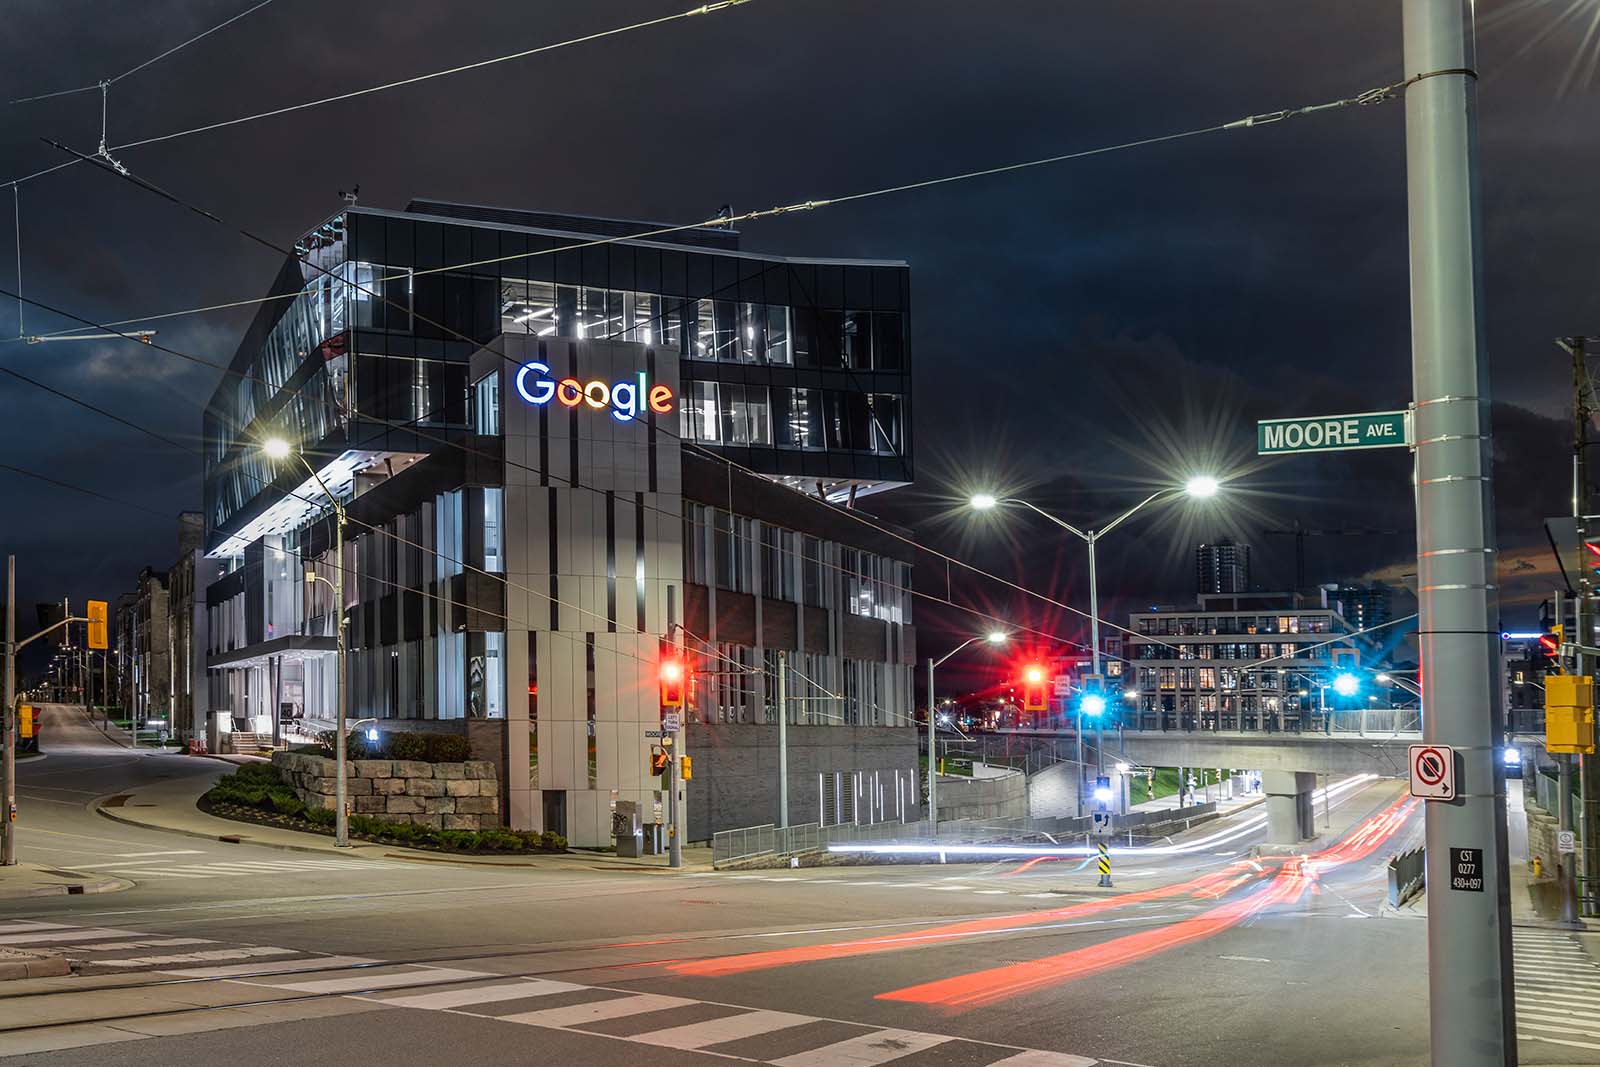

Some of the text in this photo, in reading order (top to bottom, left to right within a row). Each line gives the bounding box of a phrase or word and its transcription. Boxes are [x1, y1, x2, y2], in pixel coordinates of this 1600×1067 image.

[516, 361, 673, 422] Google
[1264, 420, 1397, 449] MOORE AVE.
[1460, 850, 1473, 862] CST
[1458, 863, 1475, 875] 0277
[1453, 877, 1481, 889] 430+097
